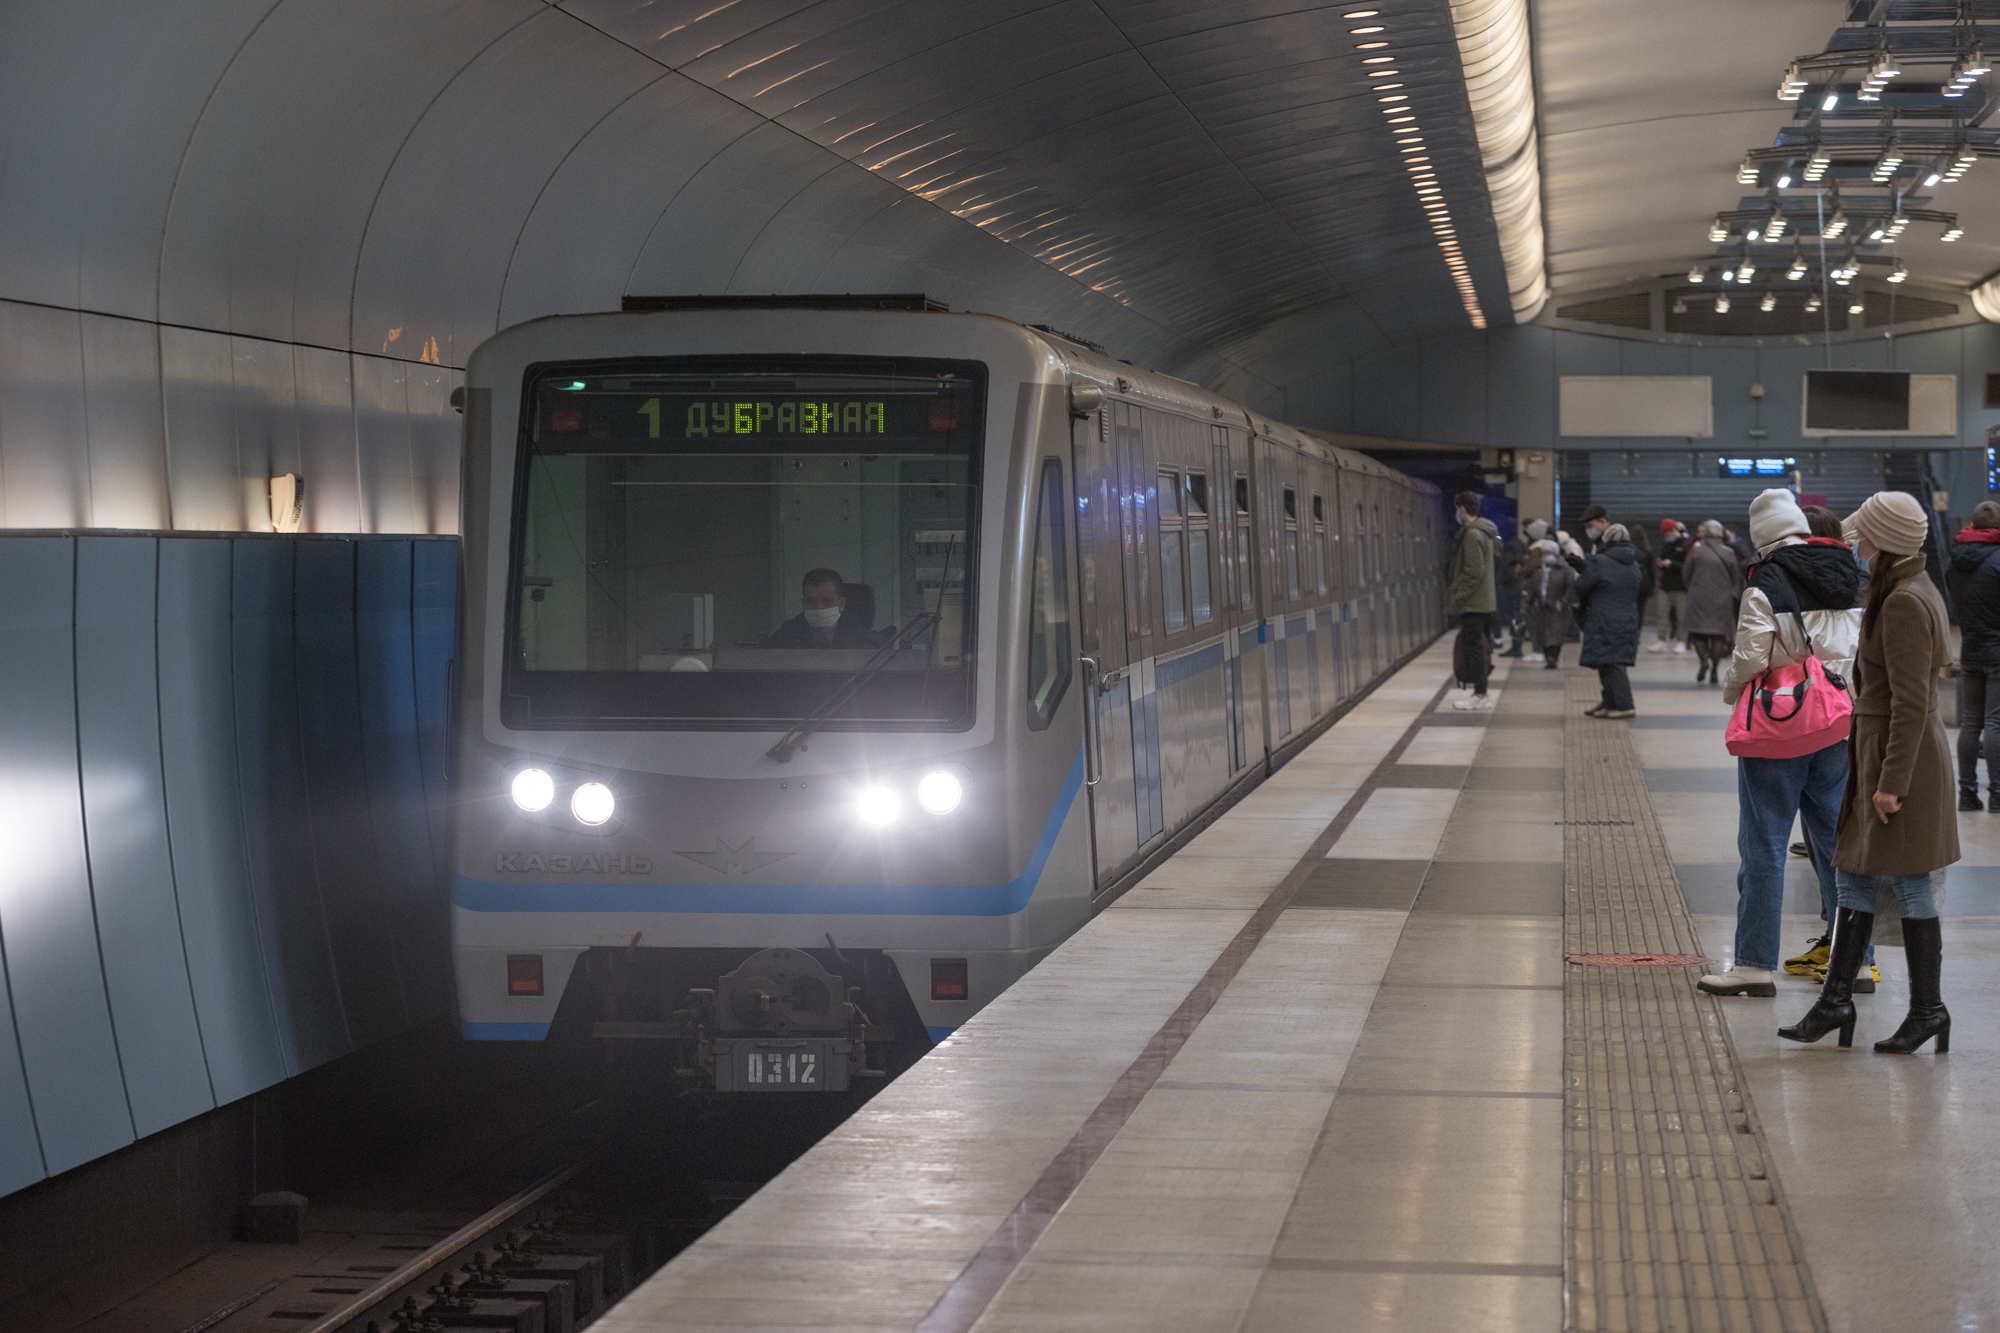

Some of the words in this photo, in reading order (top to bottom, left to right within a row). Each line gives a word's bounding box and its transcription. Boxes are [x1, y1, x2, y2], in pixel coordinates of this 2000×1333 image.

[637, 398, 660, 438] 1
[685, 402, 884, 438] ДУБРАВНАЯ
[496, 853, 653, 873] КАЗАНЬ
[748, 1053, 815, 1083] 0312
